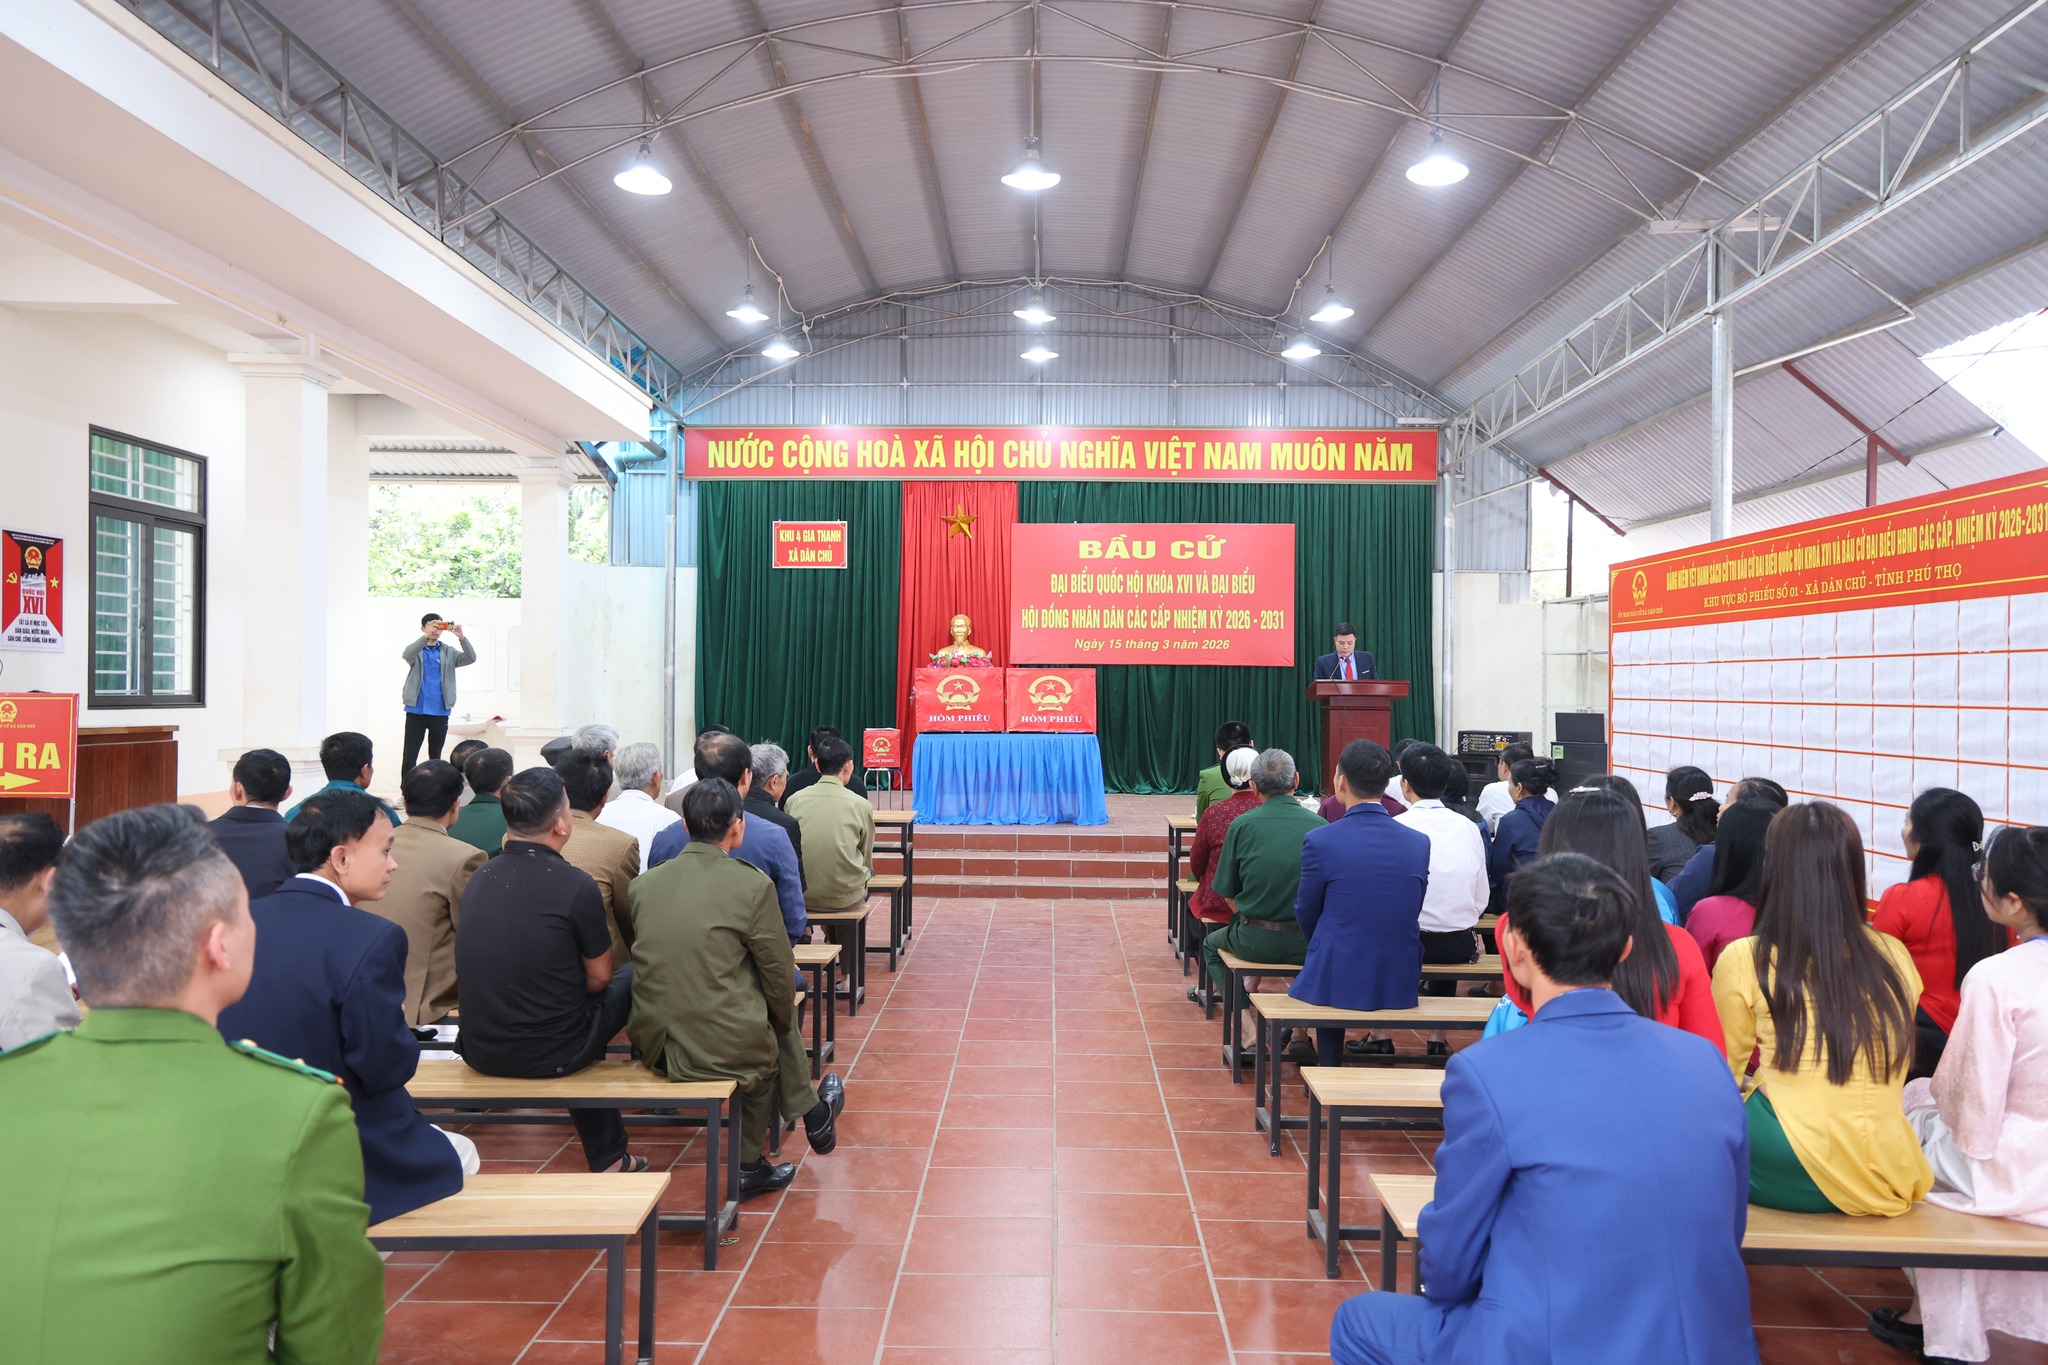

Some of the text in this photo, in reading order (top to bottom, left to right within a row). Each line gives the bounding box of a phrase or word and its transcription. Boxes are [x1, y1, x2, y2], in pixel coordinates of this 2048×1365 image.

[707, 432, 1413, 476] NƯỚC CỘNG HOÀ XÃ HỘI CHỦ NGHĨA VIỆT NAM MUÔN NĂM
[779, 530, 841, 542] KHU 4 GIA THANH
[1079, 534, 1227, 559] BẦU CỬ
[1722, 554, 1730, 582] CỬ
[1729, 559, 1737, 581] TRI
[1737, 551, 1748, 580] BẦU
[1748, 549, 1756, 578] CỬ
[1756, 554, 1765, 582] ĐẠI
[1765, 544, 1778, 575] BIỂU
[1778, 543, 1793, 576] QUỐC
[1793, 543, 1804, 576] HỘI
[1804, 540, 1821, 569] KHOÁ
[1821, 543, 1832, 567] XVI
[1832, 536, 1841, 565] VÀ
[1841, 530, 1855, 563] BẦU
[1856, 527, 1867, 562] CỬ
[1866, 533, 1879, 565] ĐẠI
[1879, 520, 1896, 558] BIỂU
[1897, 529, 1917, 555] HĐND
[1919, 519, 1935, 551] CÁC
[1936, 511, 1954, 550] CẤP,
[1955, 510, 1984, 550] NHIỆM
[1986, 506, 1998, 541] KỲ
[1998, 502, 2048, 539] 2026-2031
[788, 545, 832, 562] XÃ DÂN CHỦ
[1051, 566, 1255, 598] ĐẠI BIỂU QUỐC HỘI KHÓA XVI VÀ ĐẠI BIỂU
[1704, 595, 1719, 608] KHU
[1721, 593, 1736, 608] VỰC
[1737, 588, 1748, 604] BỎ
[1749, 584, 1775, 603] PHIẾU
[1777, 581, 1789, 599] SỐ
[1789, 588, 1799, 597] 01
[1805, 580, 1819, 596] XÃ
[1821, 577, 1843, 594] DÂN
[1845, 570, 1867, 590] CHỦ
[1875, 567, 1904, 587] TỈNH
[1906, 563, 1932, 583] PHÚ
[1935, 562, 1962, 582] THỌ
[22, 596, 44, 615] XVI
[1021, 604, 1038, 632] HỘI
[1041, 602, 1069, 628] ĐỒNG
[1072, 605, 1100, 628] NHÂN
[1103, 605, 1124, 628] DÂN
[1127, 605, 1147, 629] CÁC
[1150, 602, 1171, 629] CẤP
[1174, 605, 1207, 633] NHIỆM
[1210, 605, 1223, 629] KỲ
[1226, 609, 1250, 629] 2026
[1260, 609, 1284, 629] 2031
[1074, 639, 1230, 651] Ngày 15 tháng 3 năm 2026
[16, 742, 61, 770] RA
